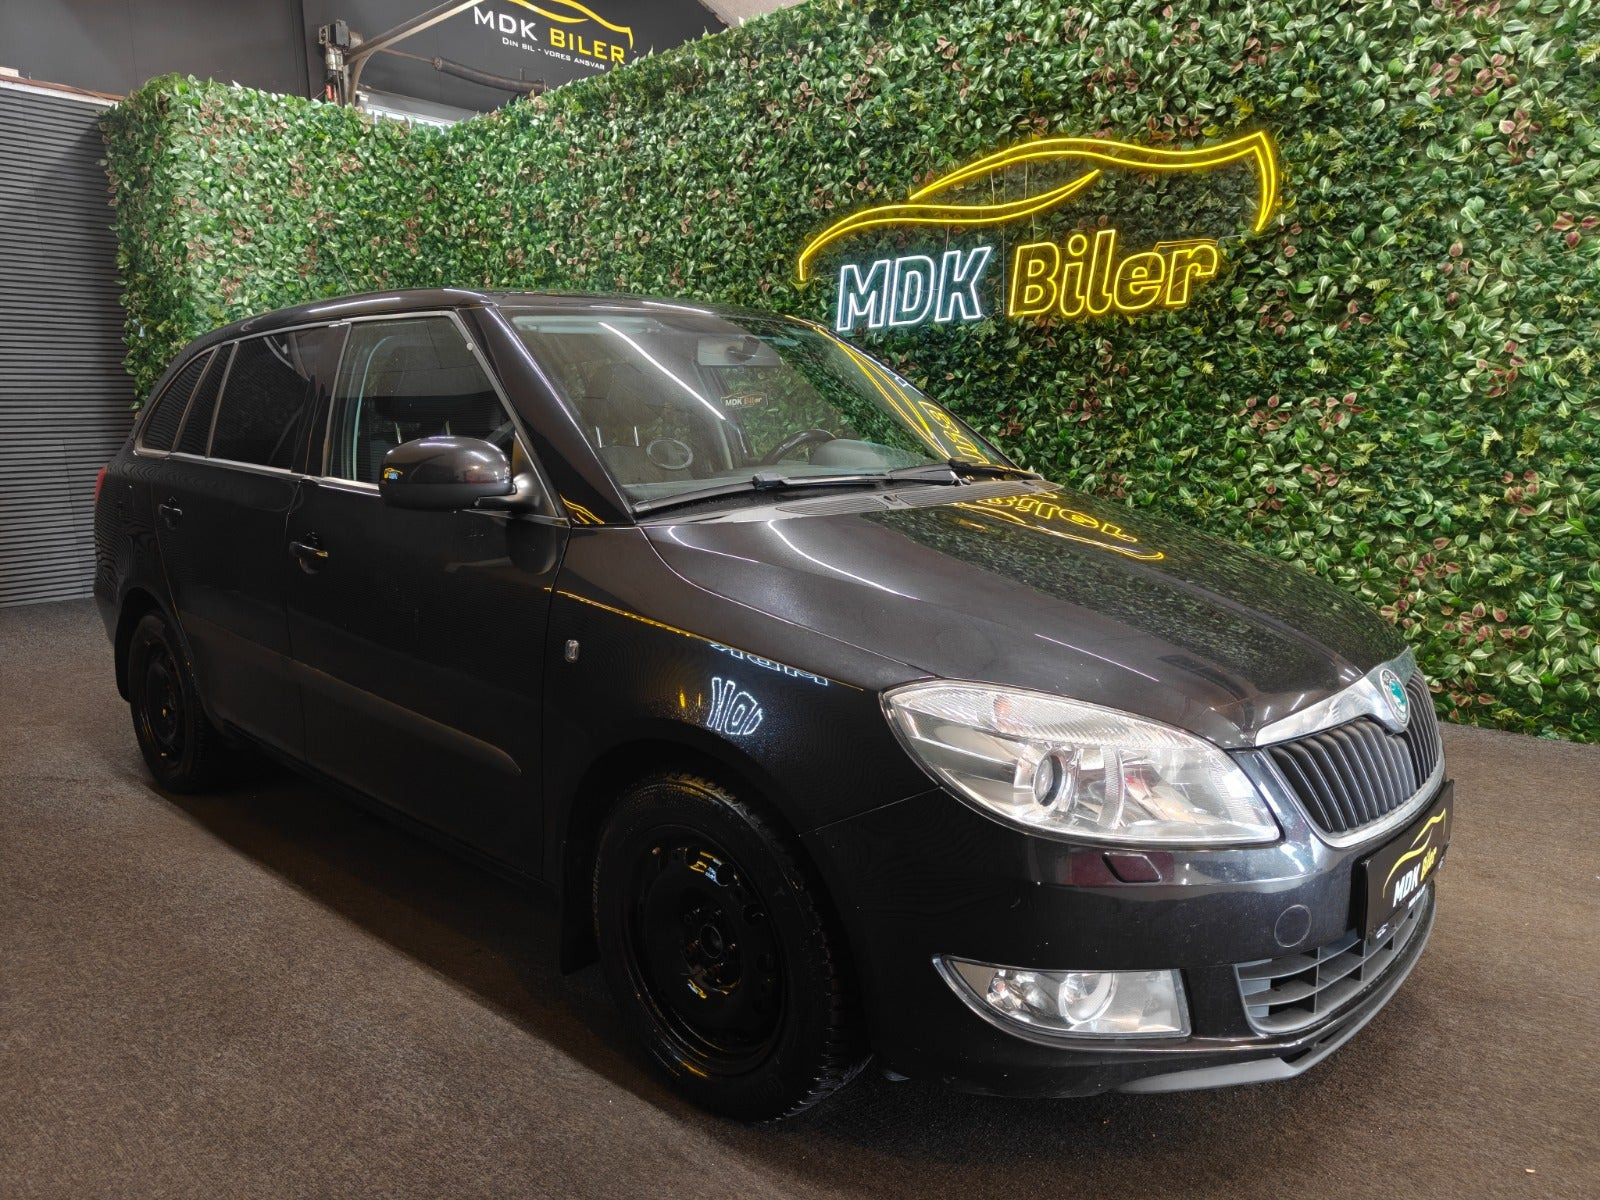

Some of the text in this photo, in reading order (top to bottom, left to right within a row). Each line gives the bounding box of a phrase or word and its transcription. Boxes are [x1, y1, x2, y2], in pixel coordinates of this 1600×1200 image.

[473, 6, 625, 65] MDK BILER
[502, 37, 519, 48] DIN
[521, 43, 535, 52] BIL
[543, 48, 571, 61] VORES
[573, 57, 605, 70] ANSVAR
[836, 229, 1219, 331] MDK Biler
[725, 397, 743, 407] MDK
[1393, 862, 1421, 908] MDK
